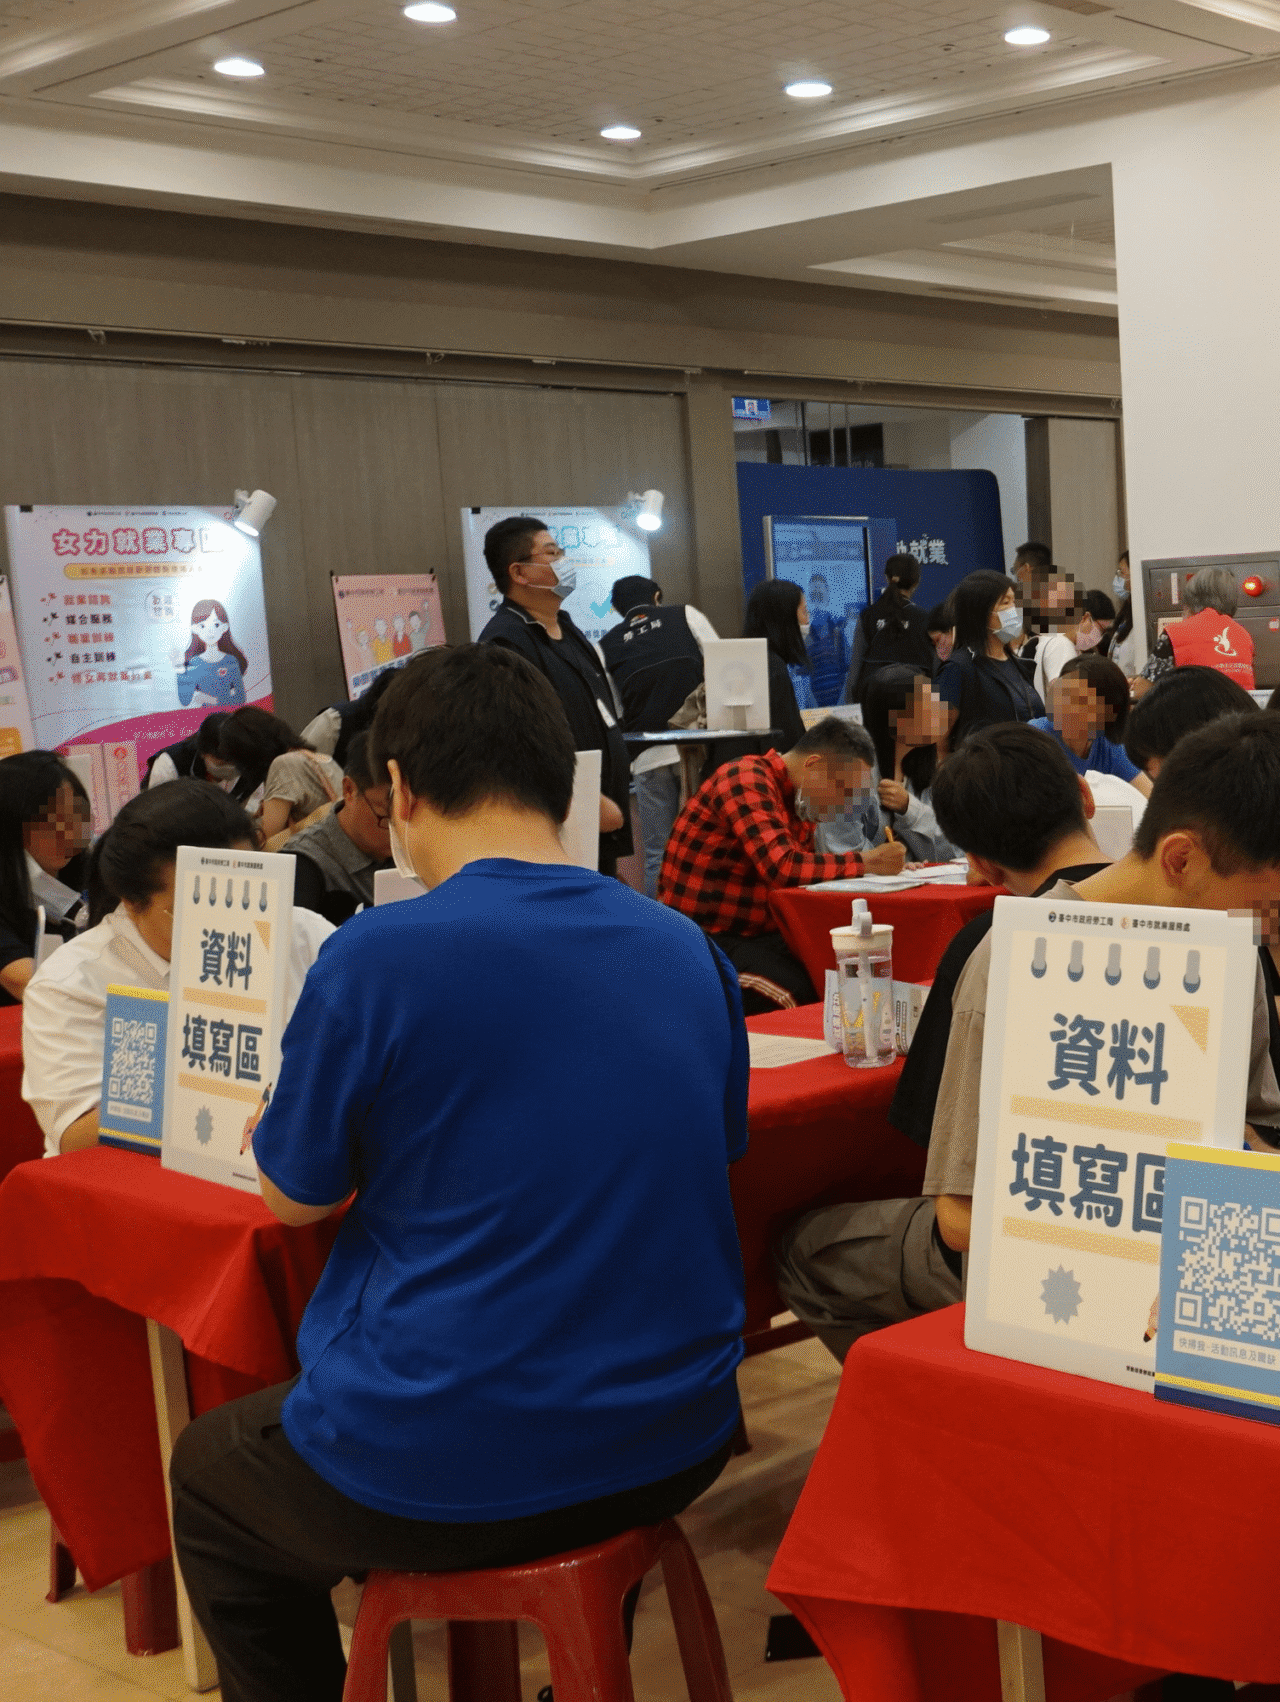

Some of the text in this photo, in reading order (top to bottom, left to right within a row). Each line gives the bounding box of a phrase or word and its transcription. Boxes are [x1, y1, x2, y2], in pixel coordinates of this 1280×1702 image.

[52, 527, 224, 556] 女力就業專
[1058, 913, 1191, 932] 臺中市政府勞工局 臺中市就業服務處
[199, 928, 253, 991] 資料
[181, 1013, 263, 1082] 填寫區
[1047, 1012, 1169, 1105] 資料
[1009, 1132, 1166, 1234] 填寫區
